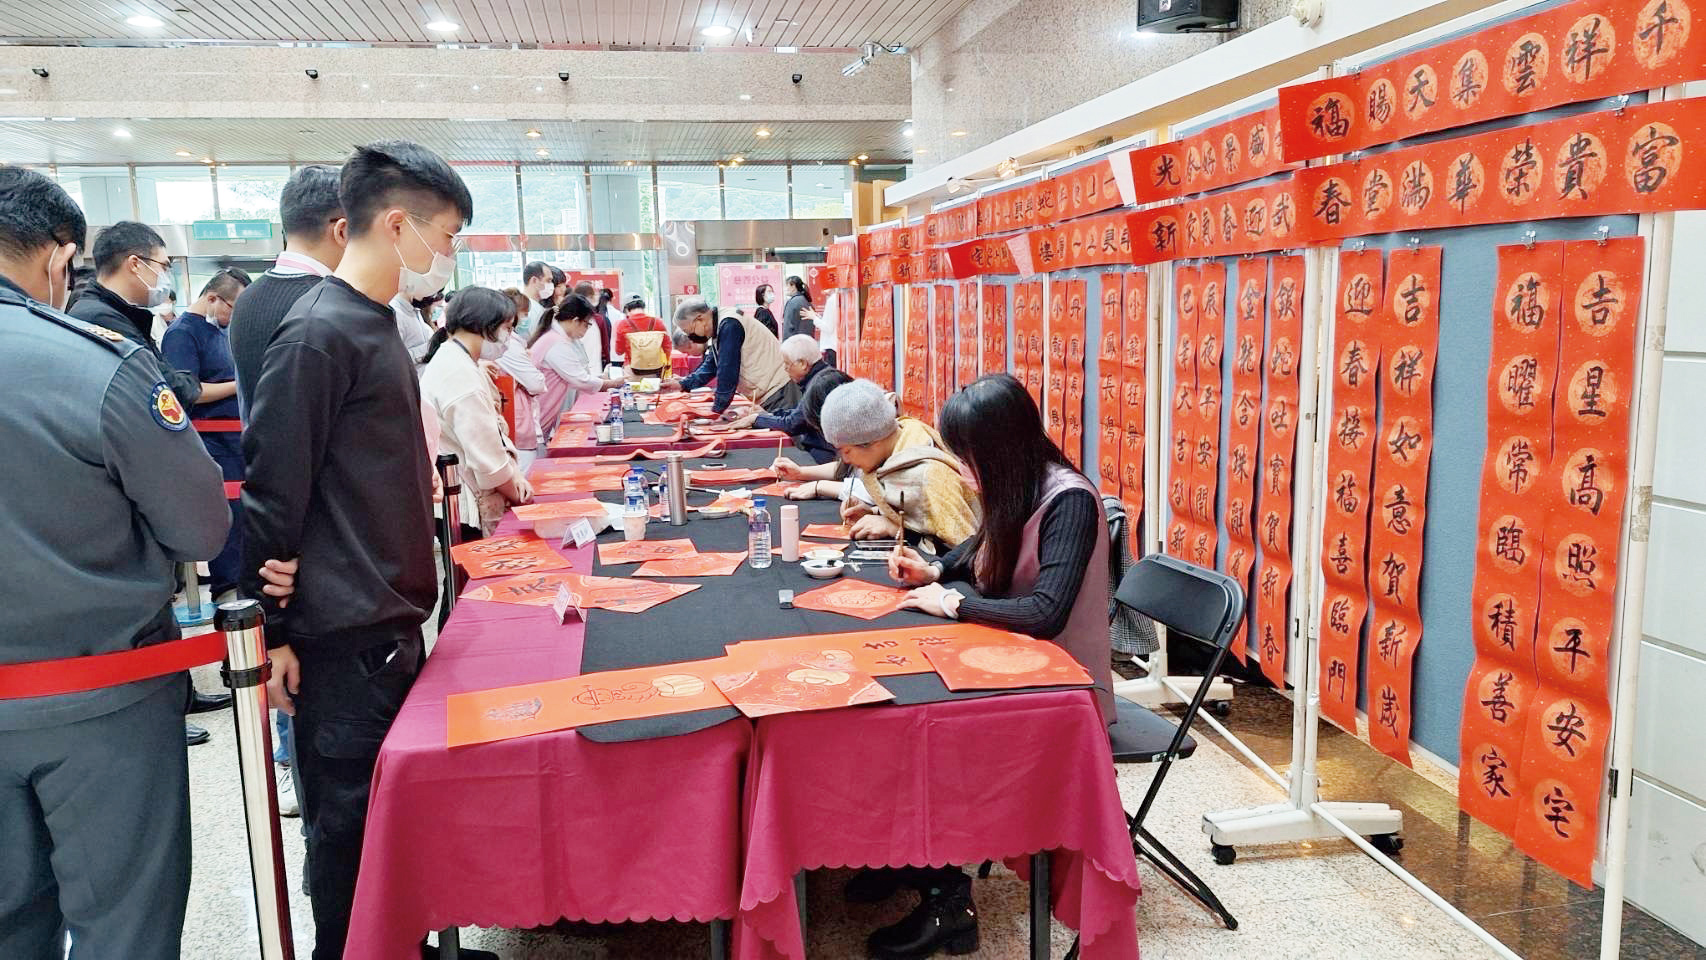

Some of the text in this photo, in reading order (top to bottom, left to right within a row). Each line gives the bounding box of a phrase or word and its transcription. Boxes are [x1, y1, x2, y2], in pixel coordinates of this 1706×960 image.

[1328, 277, 1373, 703] 迎春接福喜臨門
[1378, 275, 1426, 739] 吉祥如意賀新歲
[1480, 275, 1545, 798] 福曜常臨積善家
[1543, 275, 1619, 839] 吉星高照平安宅
